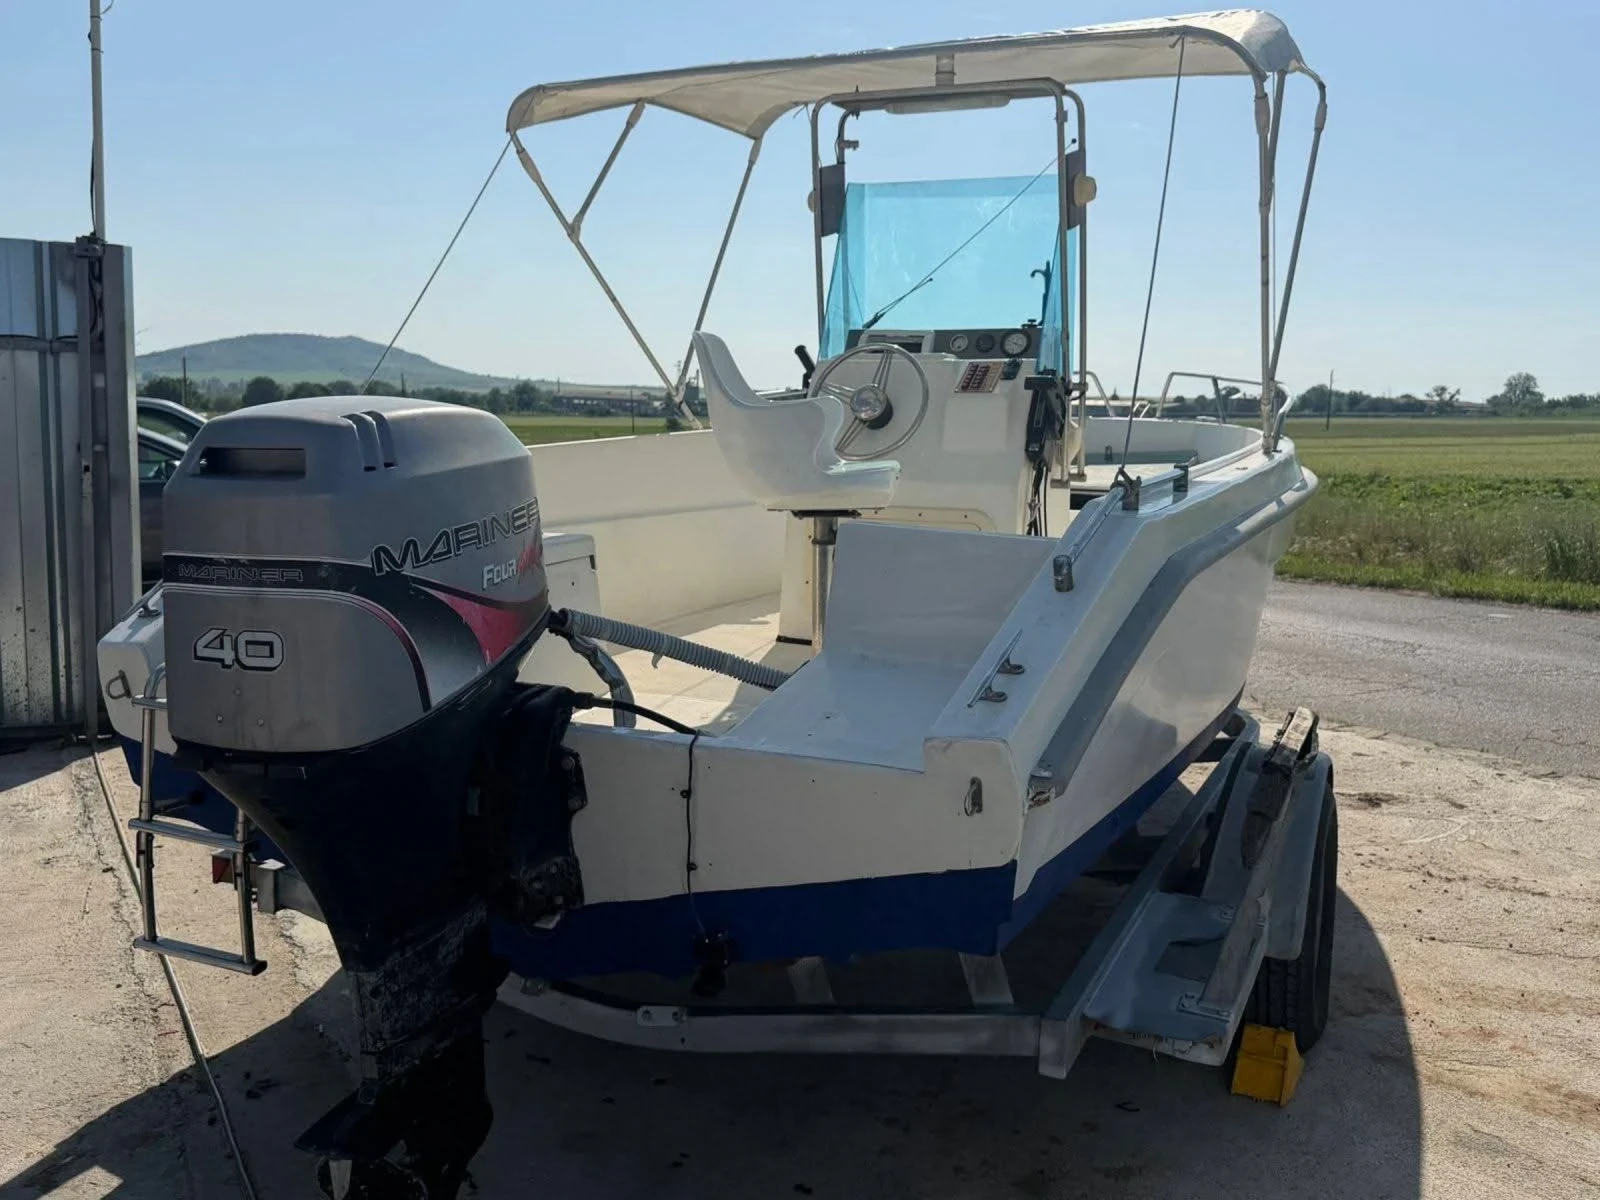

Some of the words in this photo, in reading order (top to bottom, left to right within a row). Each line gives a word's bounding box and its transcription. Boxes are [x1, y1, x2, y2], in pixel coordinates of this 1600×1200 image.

[371, 497, 540, 577] MARINER
[179, 563, 304, 582] MARINER
[193, 627, 284, 672] 40
